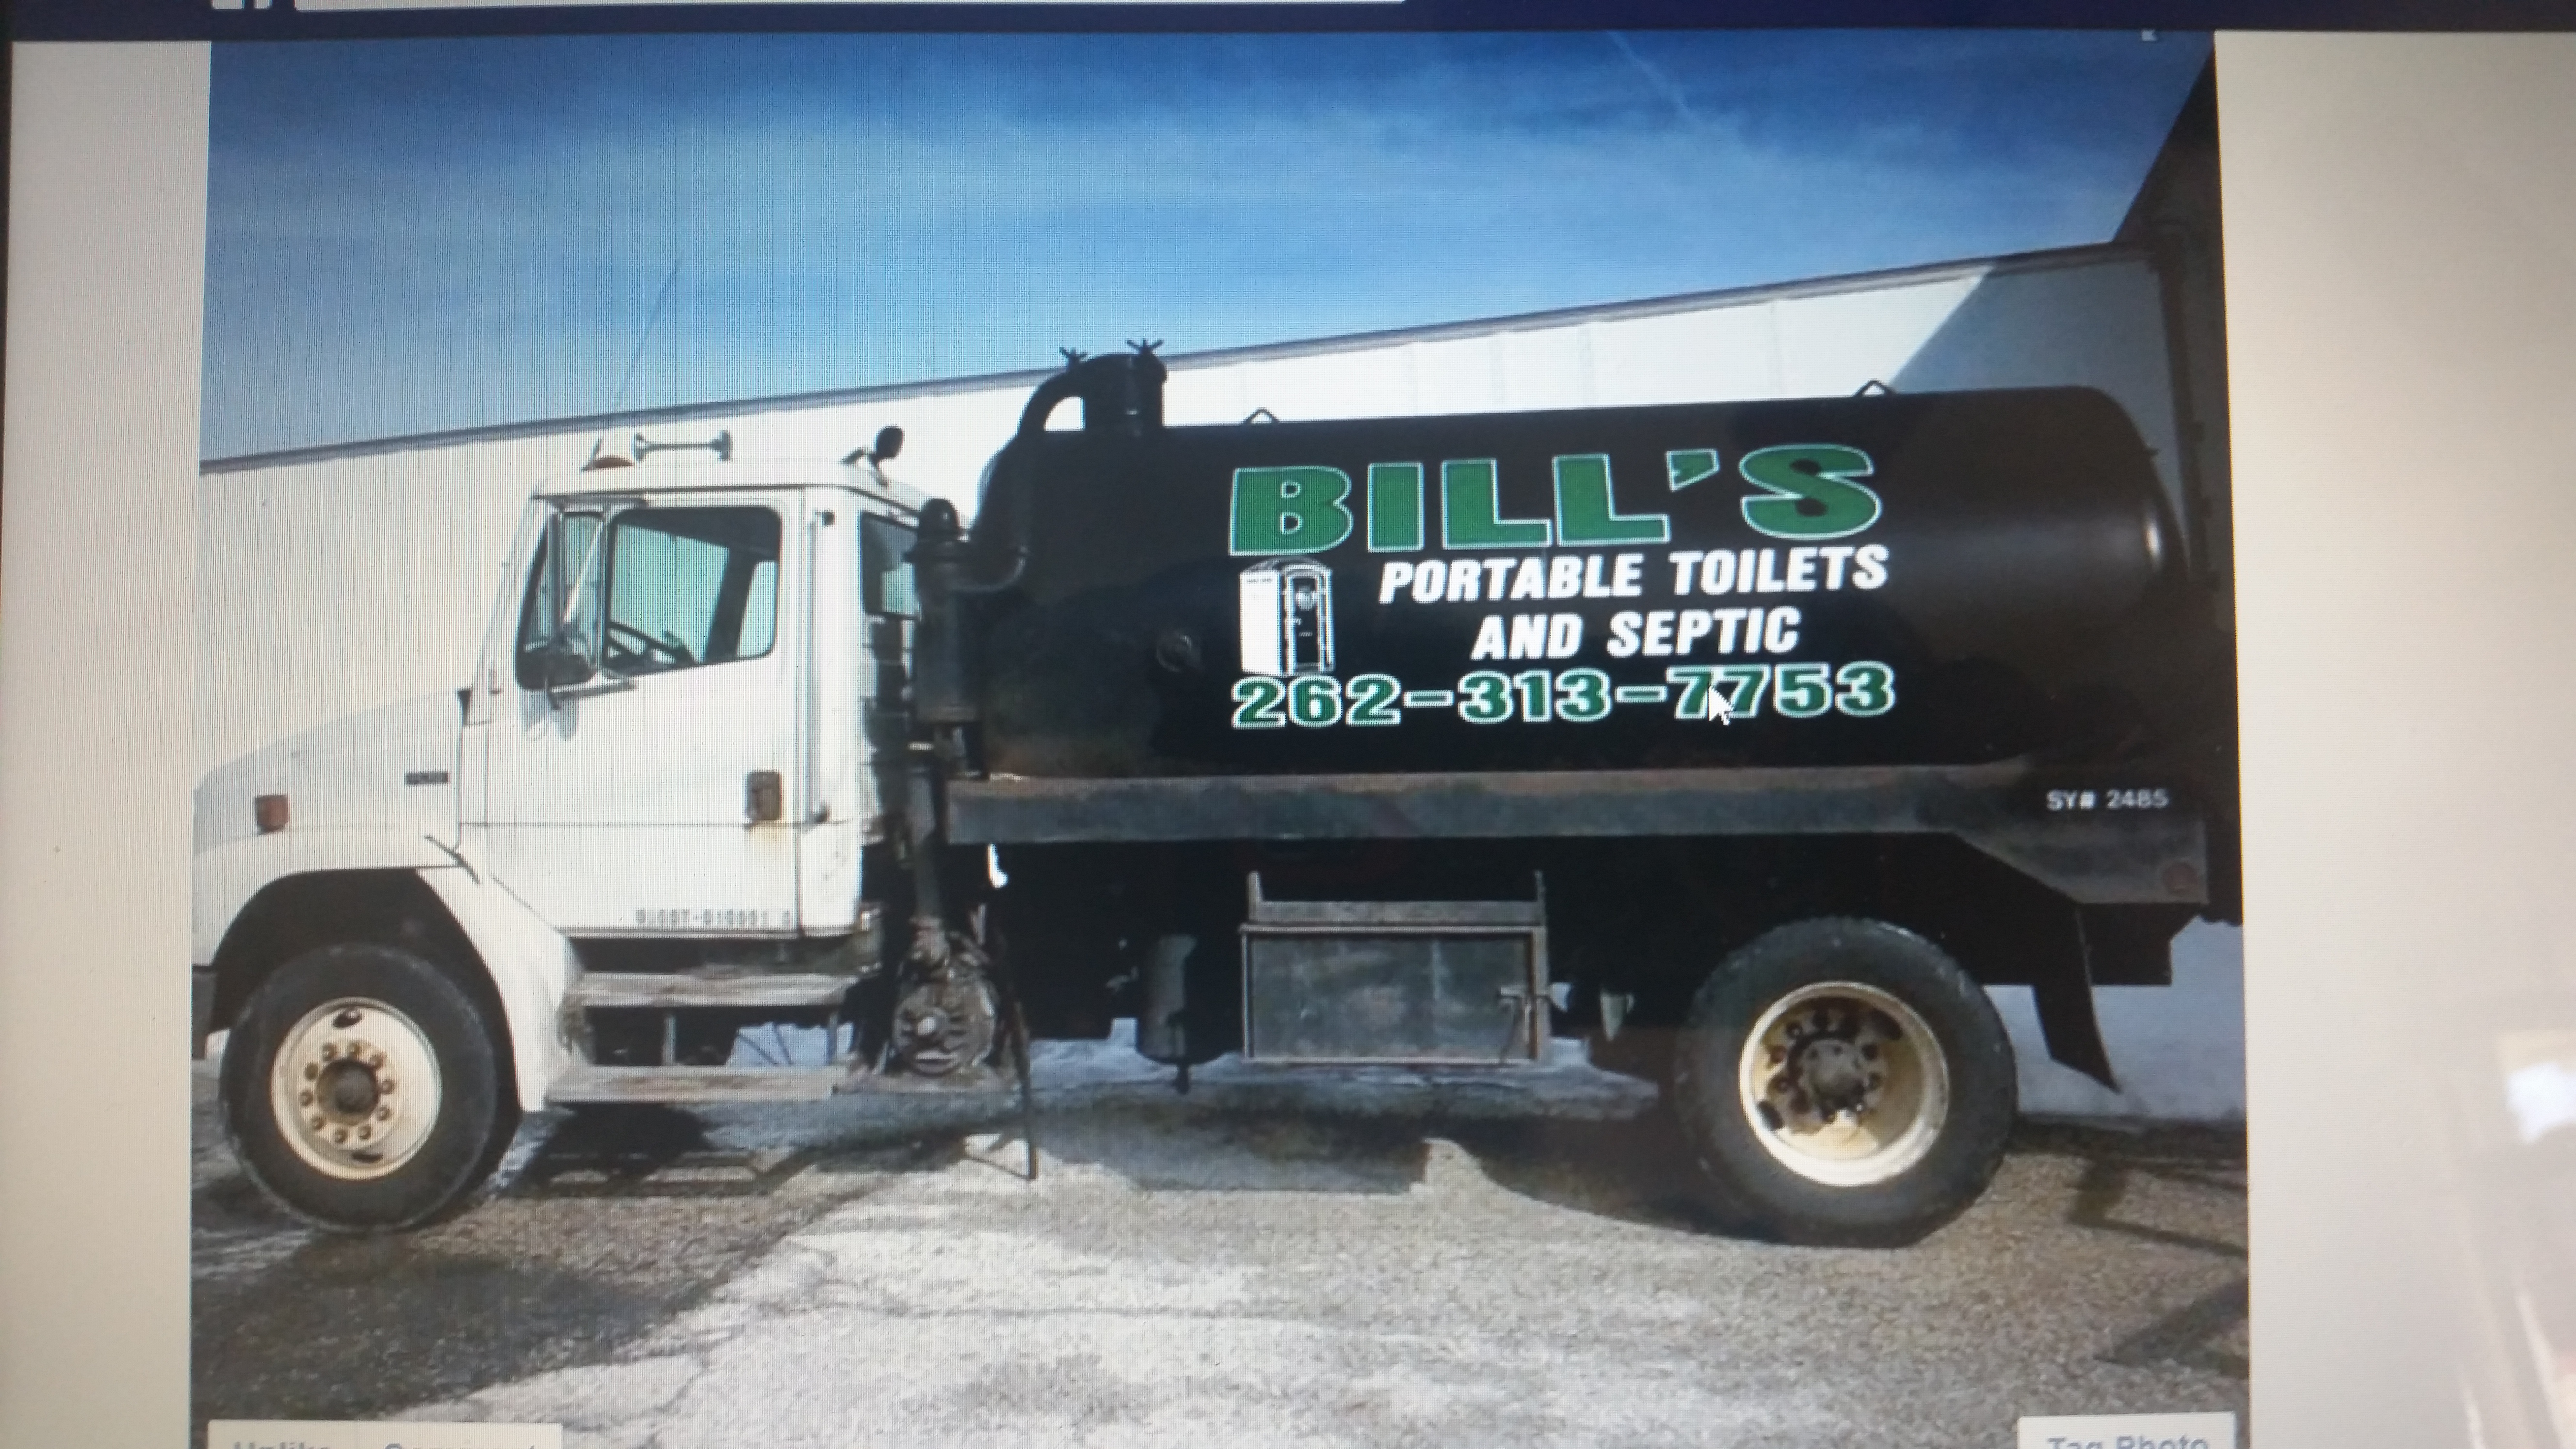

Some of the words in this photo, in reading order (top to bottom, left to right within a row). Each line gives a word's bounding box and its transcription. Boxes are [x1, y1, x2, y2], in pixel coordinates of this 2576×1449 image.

[1229, 443, 1883, 556] BILL'S
[1378, 552, 1644, 605] PORTABLE
[1669, 544, 1891, 594] TOILETS
[1470, 614, 1582, 661] AND
[1606, 606, 1802, 658] SEPTIC
[1231, 661, 1896, 729] 262-313-7753
